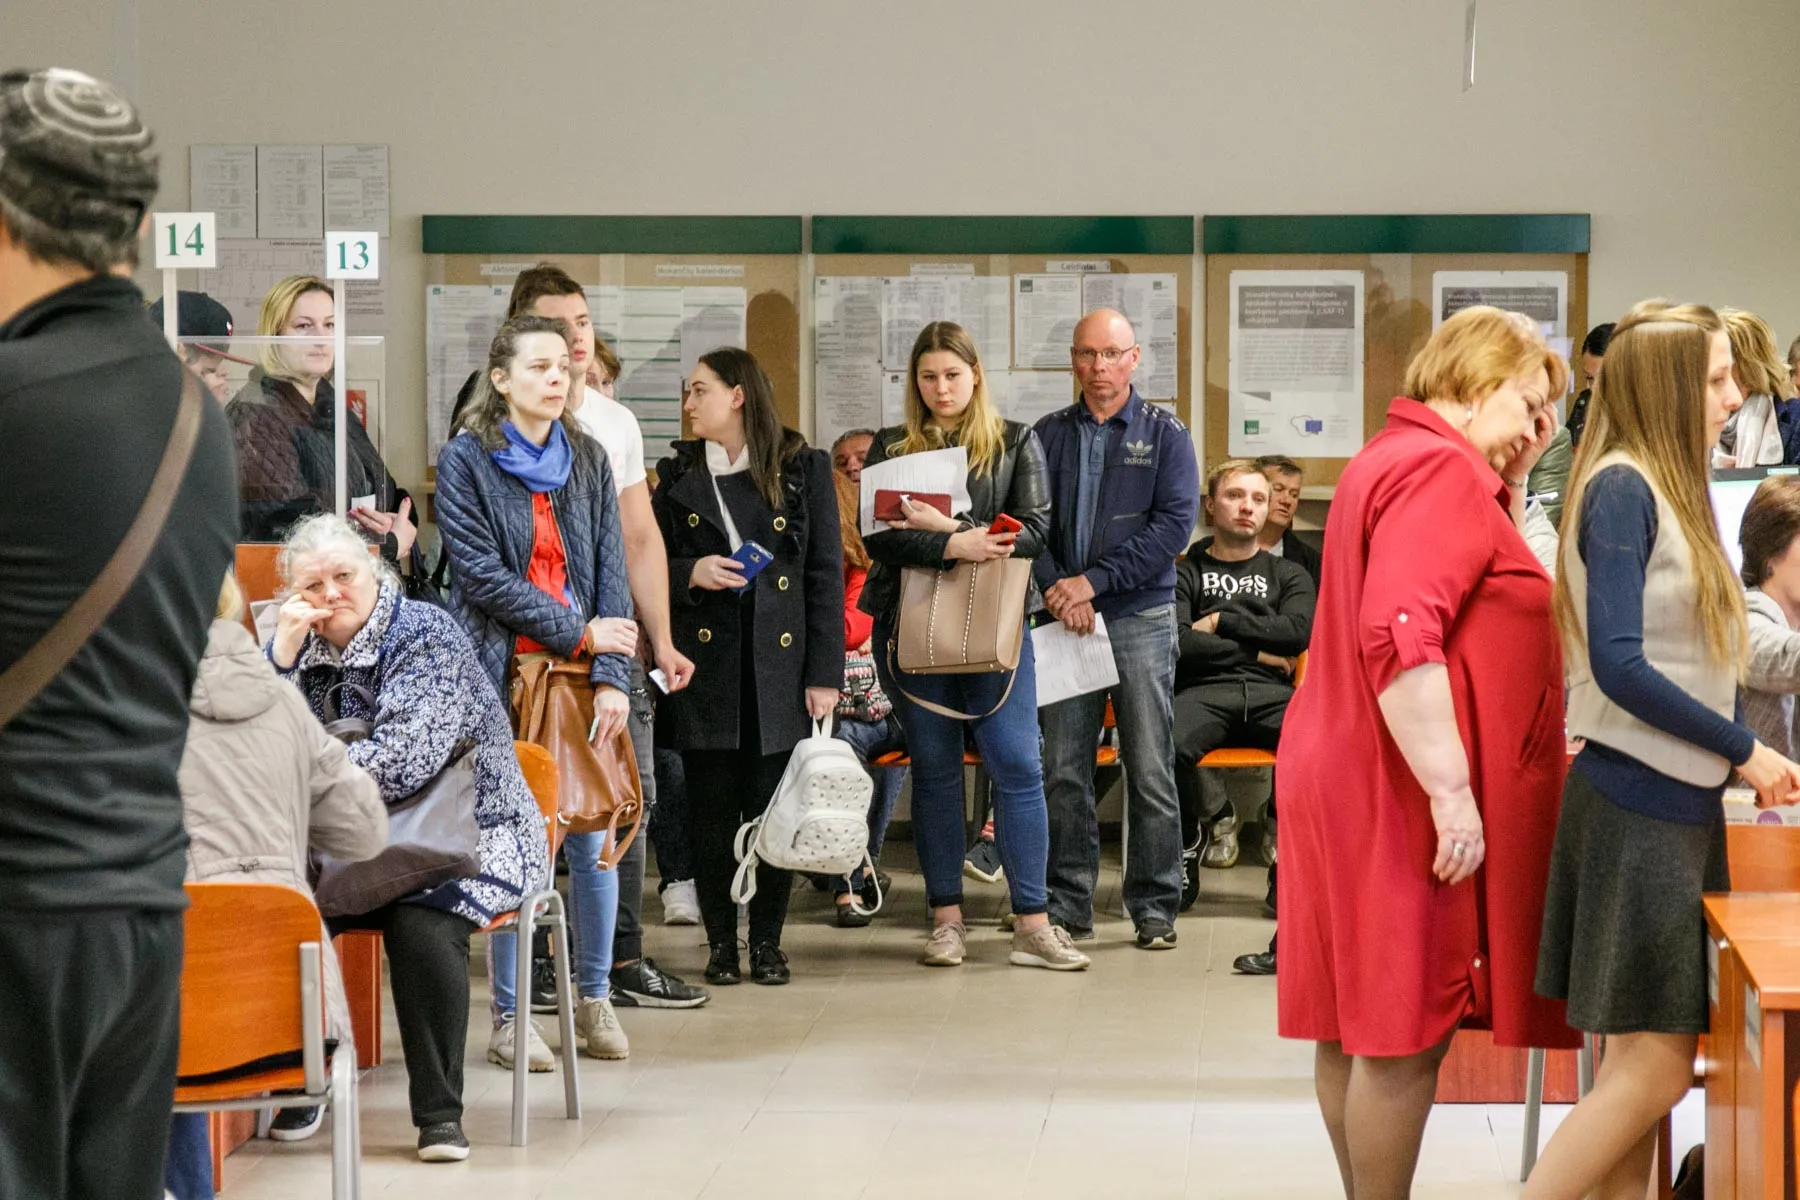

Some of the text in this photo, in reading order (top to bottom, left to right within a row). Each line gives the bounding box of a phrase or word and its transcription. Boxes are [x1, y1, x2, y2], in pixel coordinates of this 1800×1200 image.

[165, 222, 205, 256] 14
[336, 240, 369, 270] 13
[1123, 456, 1152, 465] adidas
[1202, 572, 1268, 595] BOSS
